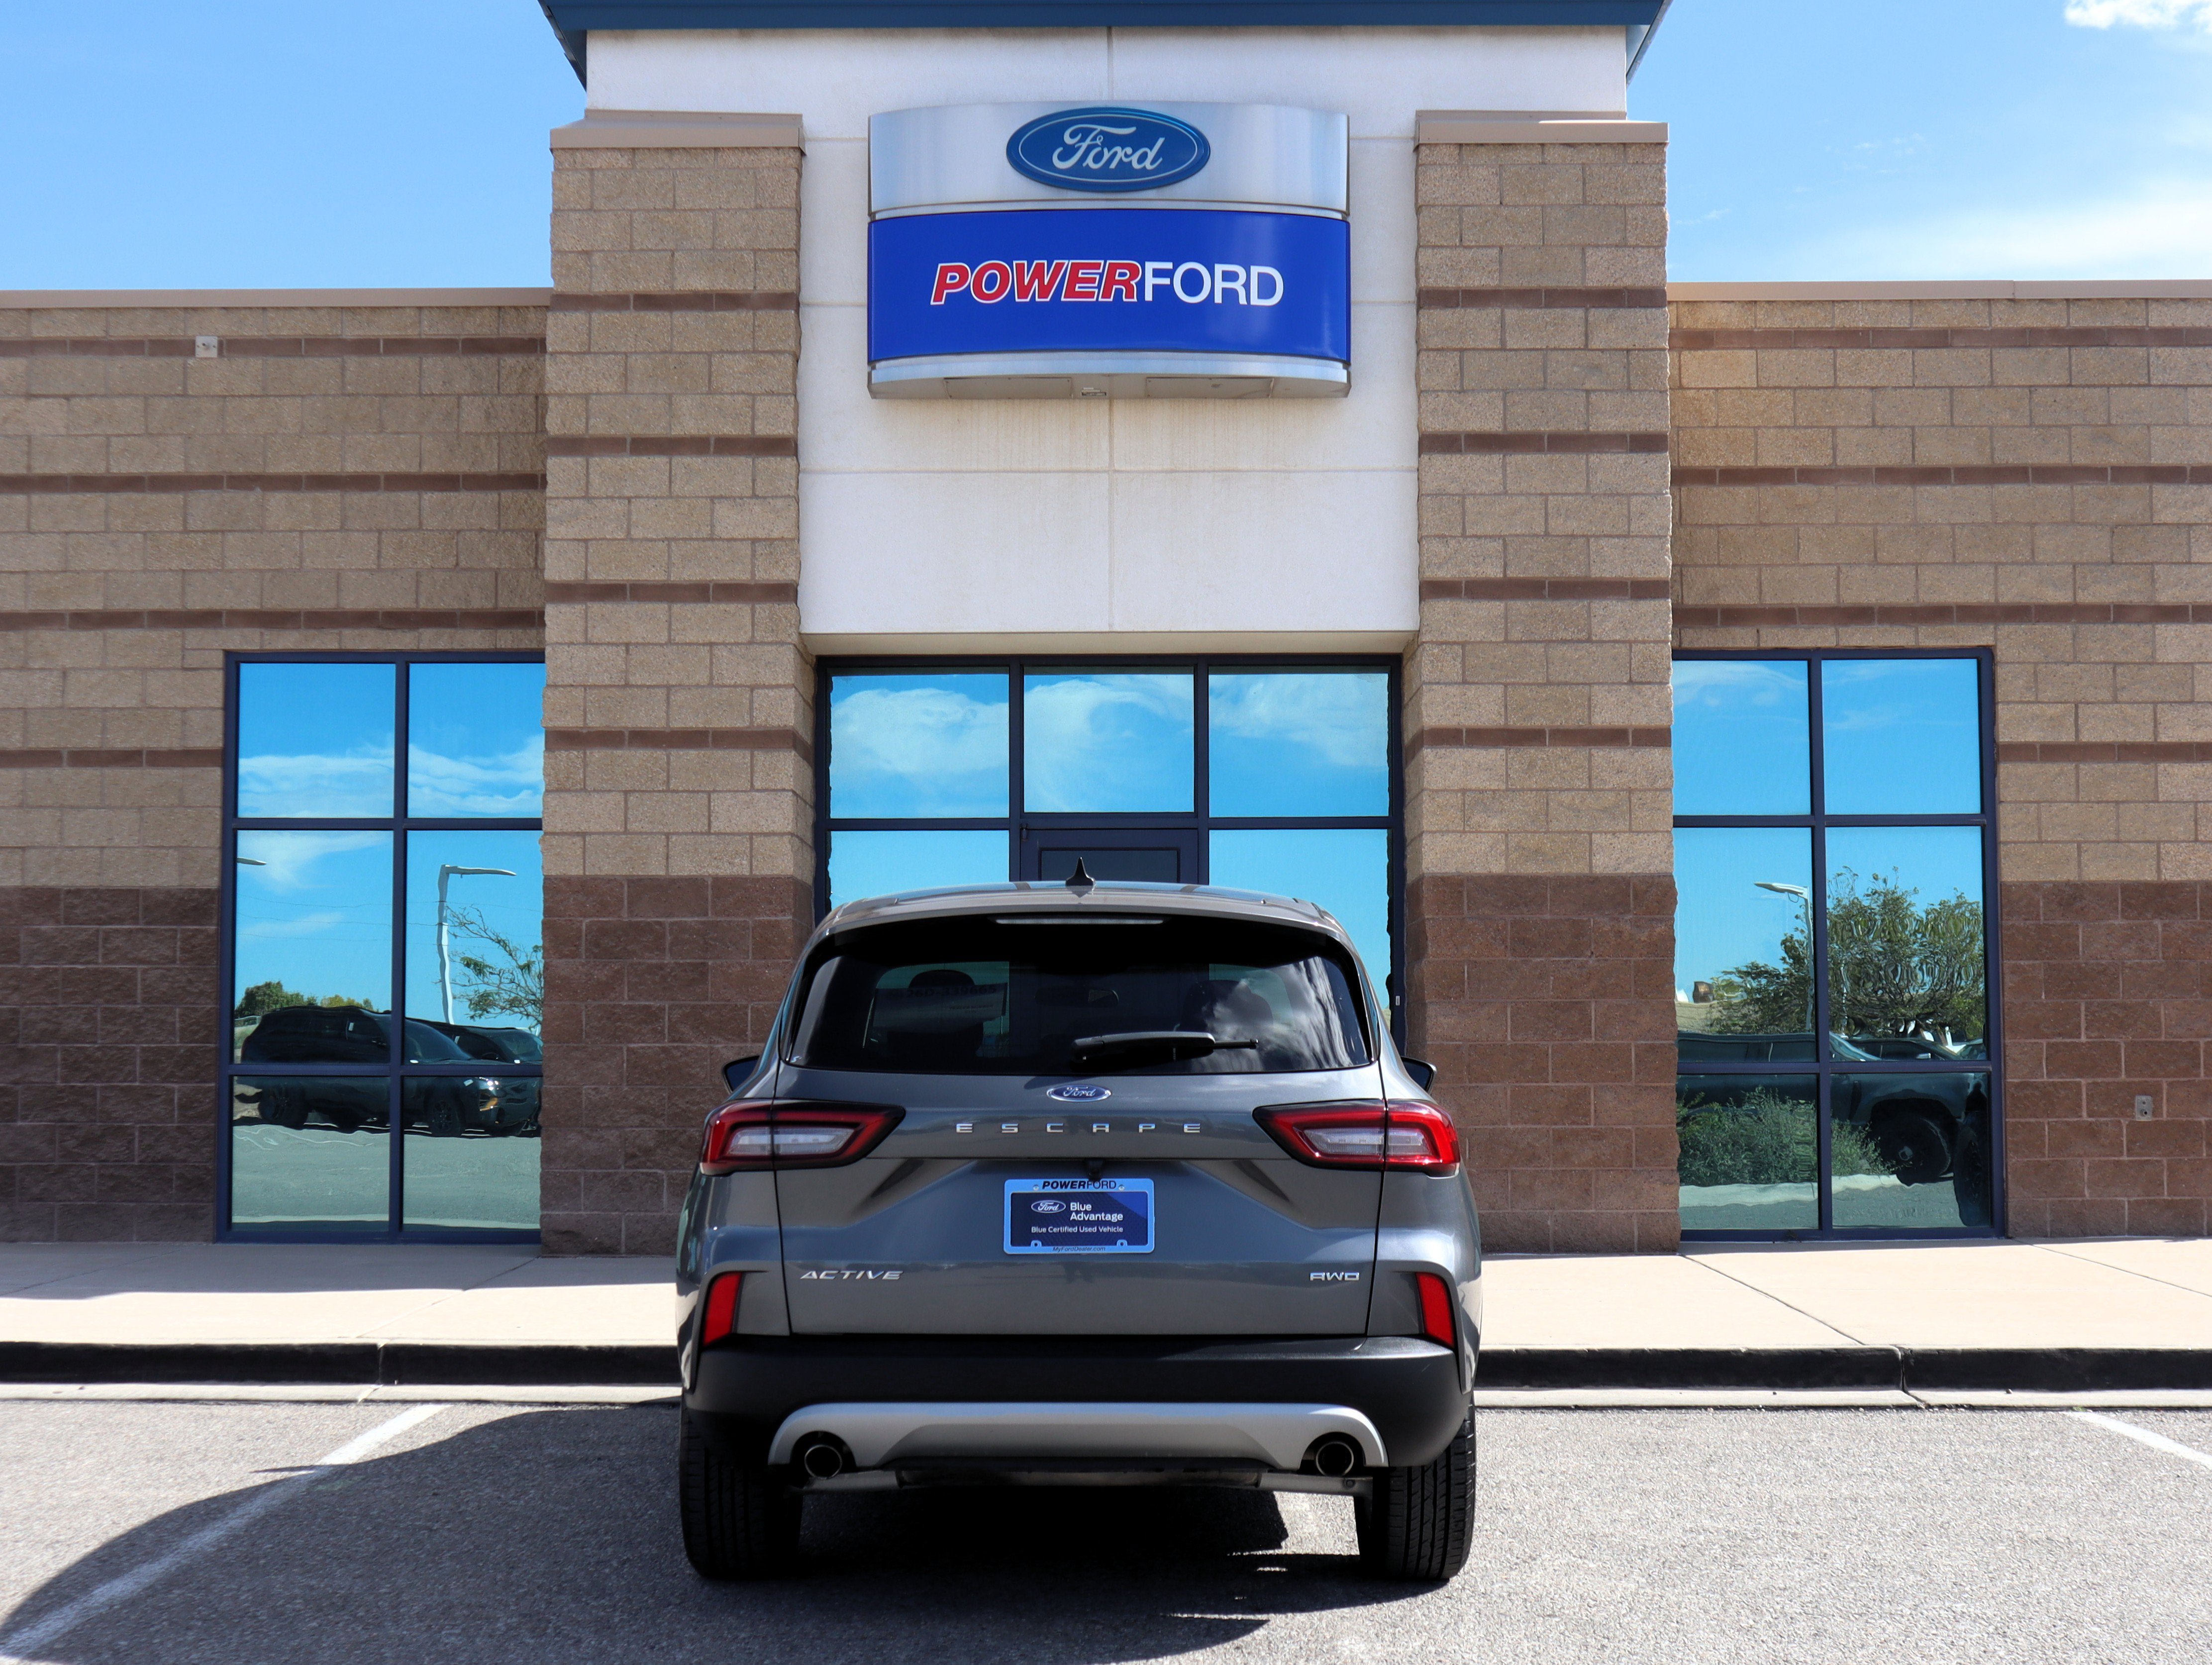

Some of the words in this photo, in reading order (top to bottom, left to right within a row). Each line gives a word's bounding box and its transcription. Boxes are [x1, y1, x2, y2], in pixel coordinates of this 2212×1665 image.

[1052, 123, 1166, 171] Ford
[930, 259, 1284, 306] POWERFORD
[1063, 1086, 1097, 1097] Ford
[956, 1123, 1201, 1133] ESCAPE
[1042, 1180, 1116, 1189] POWERFORD
[1037, 1202, 1059, 1212] Ford
[1070, 1202, 1092, 1211] Blue
[1070, 1212, 1123, 1222] Advantage
[800, 1271, 904, 1280] ACTIVE
[1309, 1273, 1360, 1281] AWD
